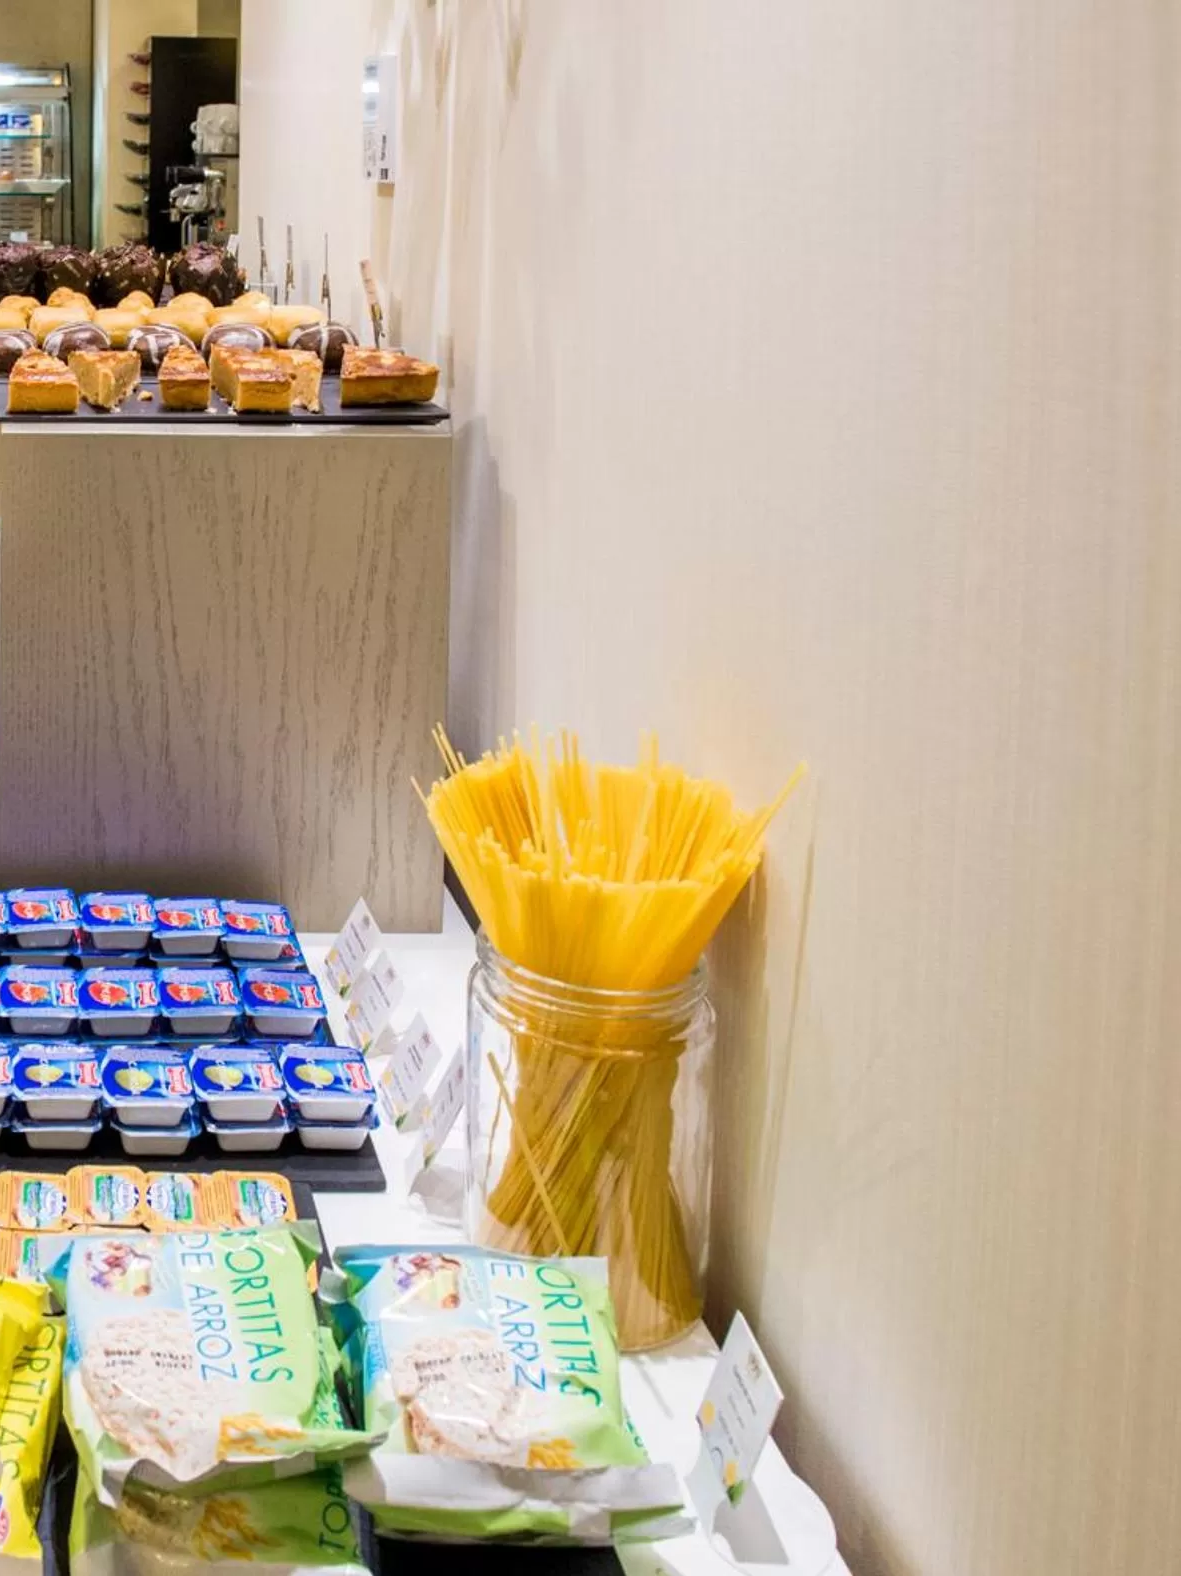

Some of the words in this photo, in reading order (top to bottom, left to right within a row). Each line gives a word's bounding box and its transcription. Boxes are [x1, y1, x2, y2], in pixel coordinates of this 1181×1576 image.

[178, 1231, 215, 1267] DE
[489, 1261, 526, 1279] E
[185, 1282, 238, 1381] ARROZ
[535, 1264, 604, 1408] ORTITAS
